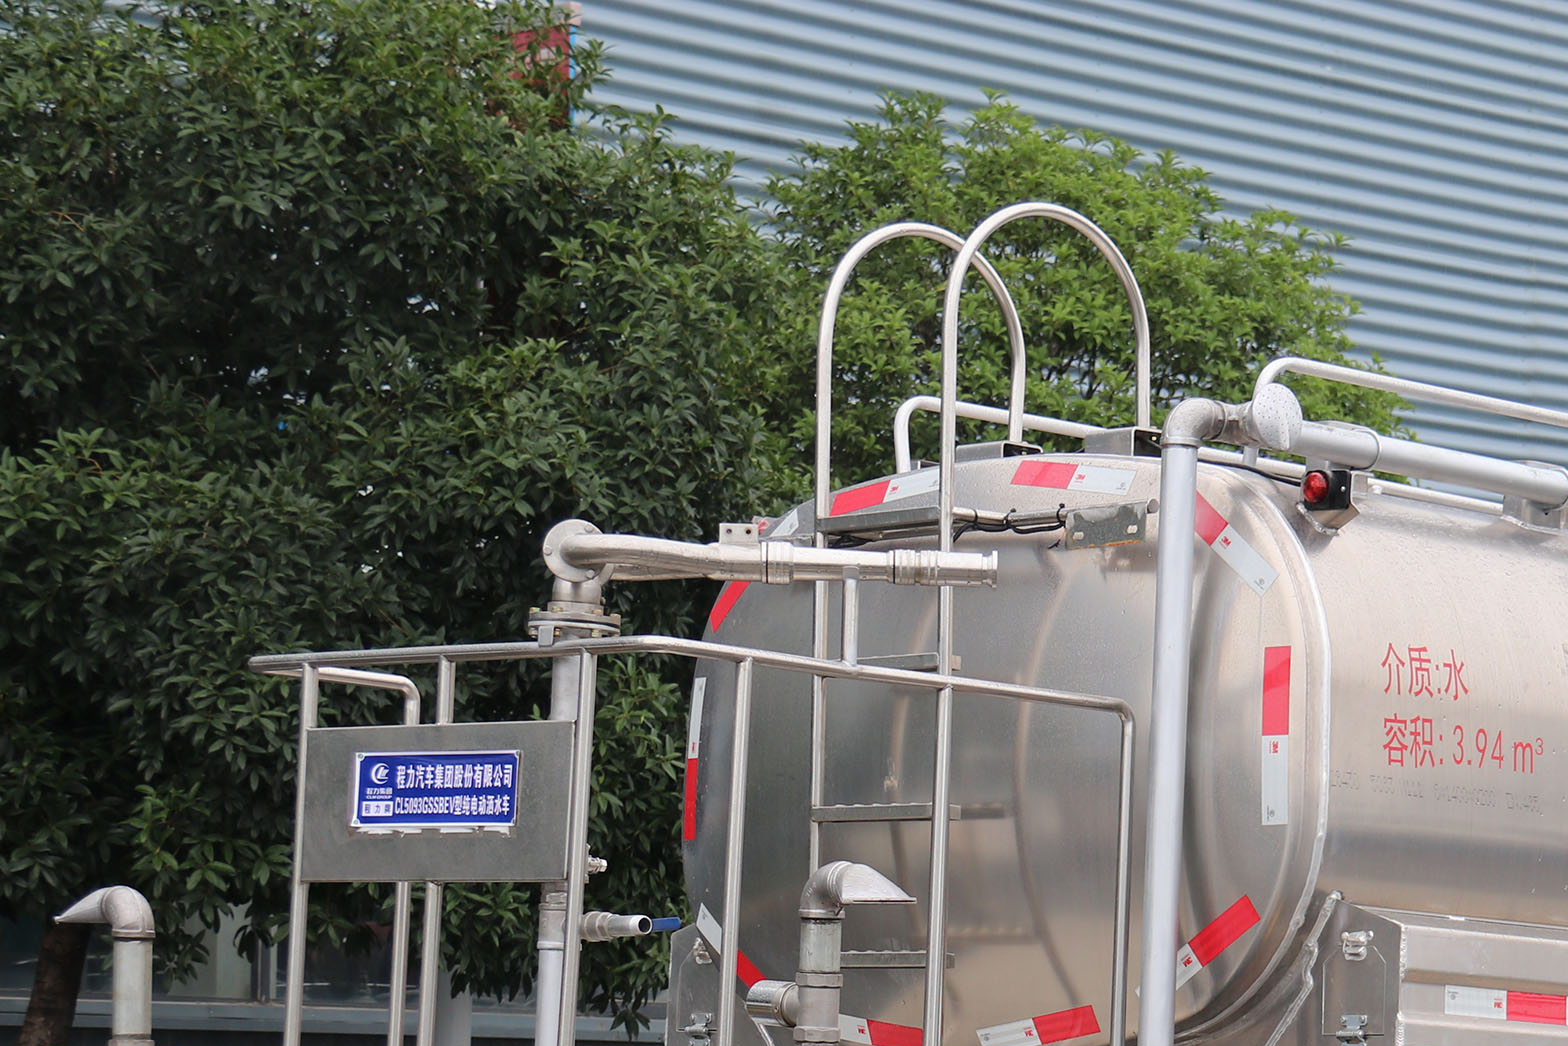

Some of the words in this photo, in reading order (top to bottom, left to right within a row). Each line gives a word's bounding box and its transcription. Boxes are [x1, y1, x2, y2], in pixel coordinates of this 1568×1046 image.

[396, 764, 513, 789] 程力汽车集团股份有限公司
